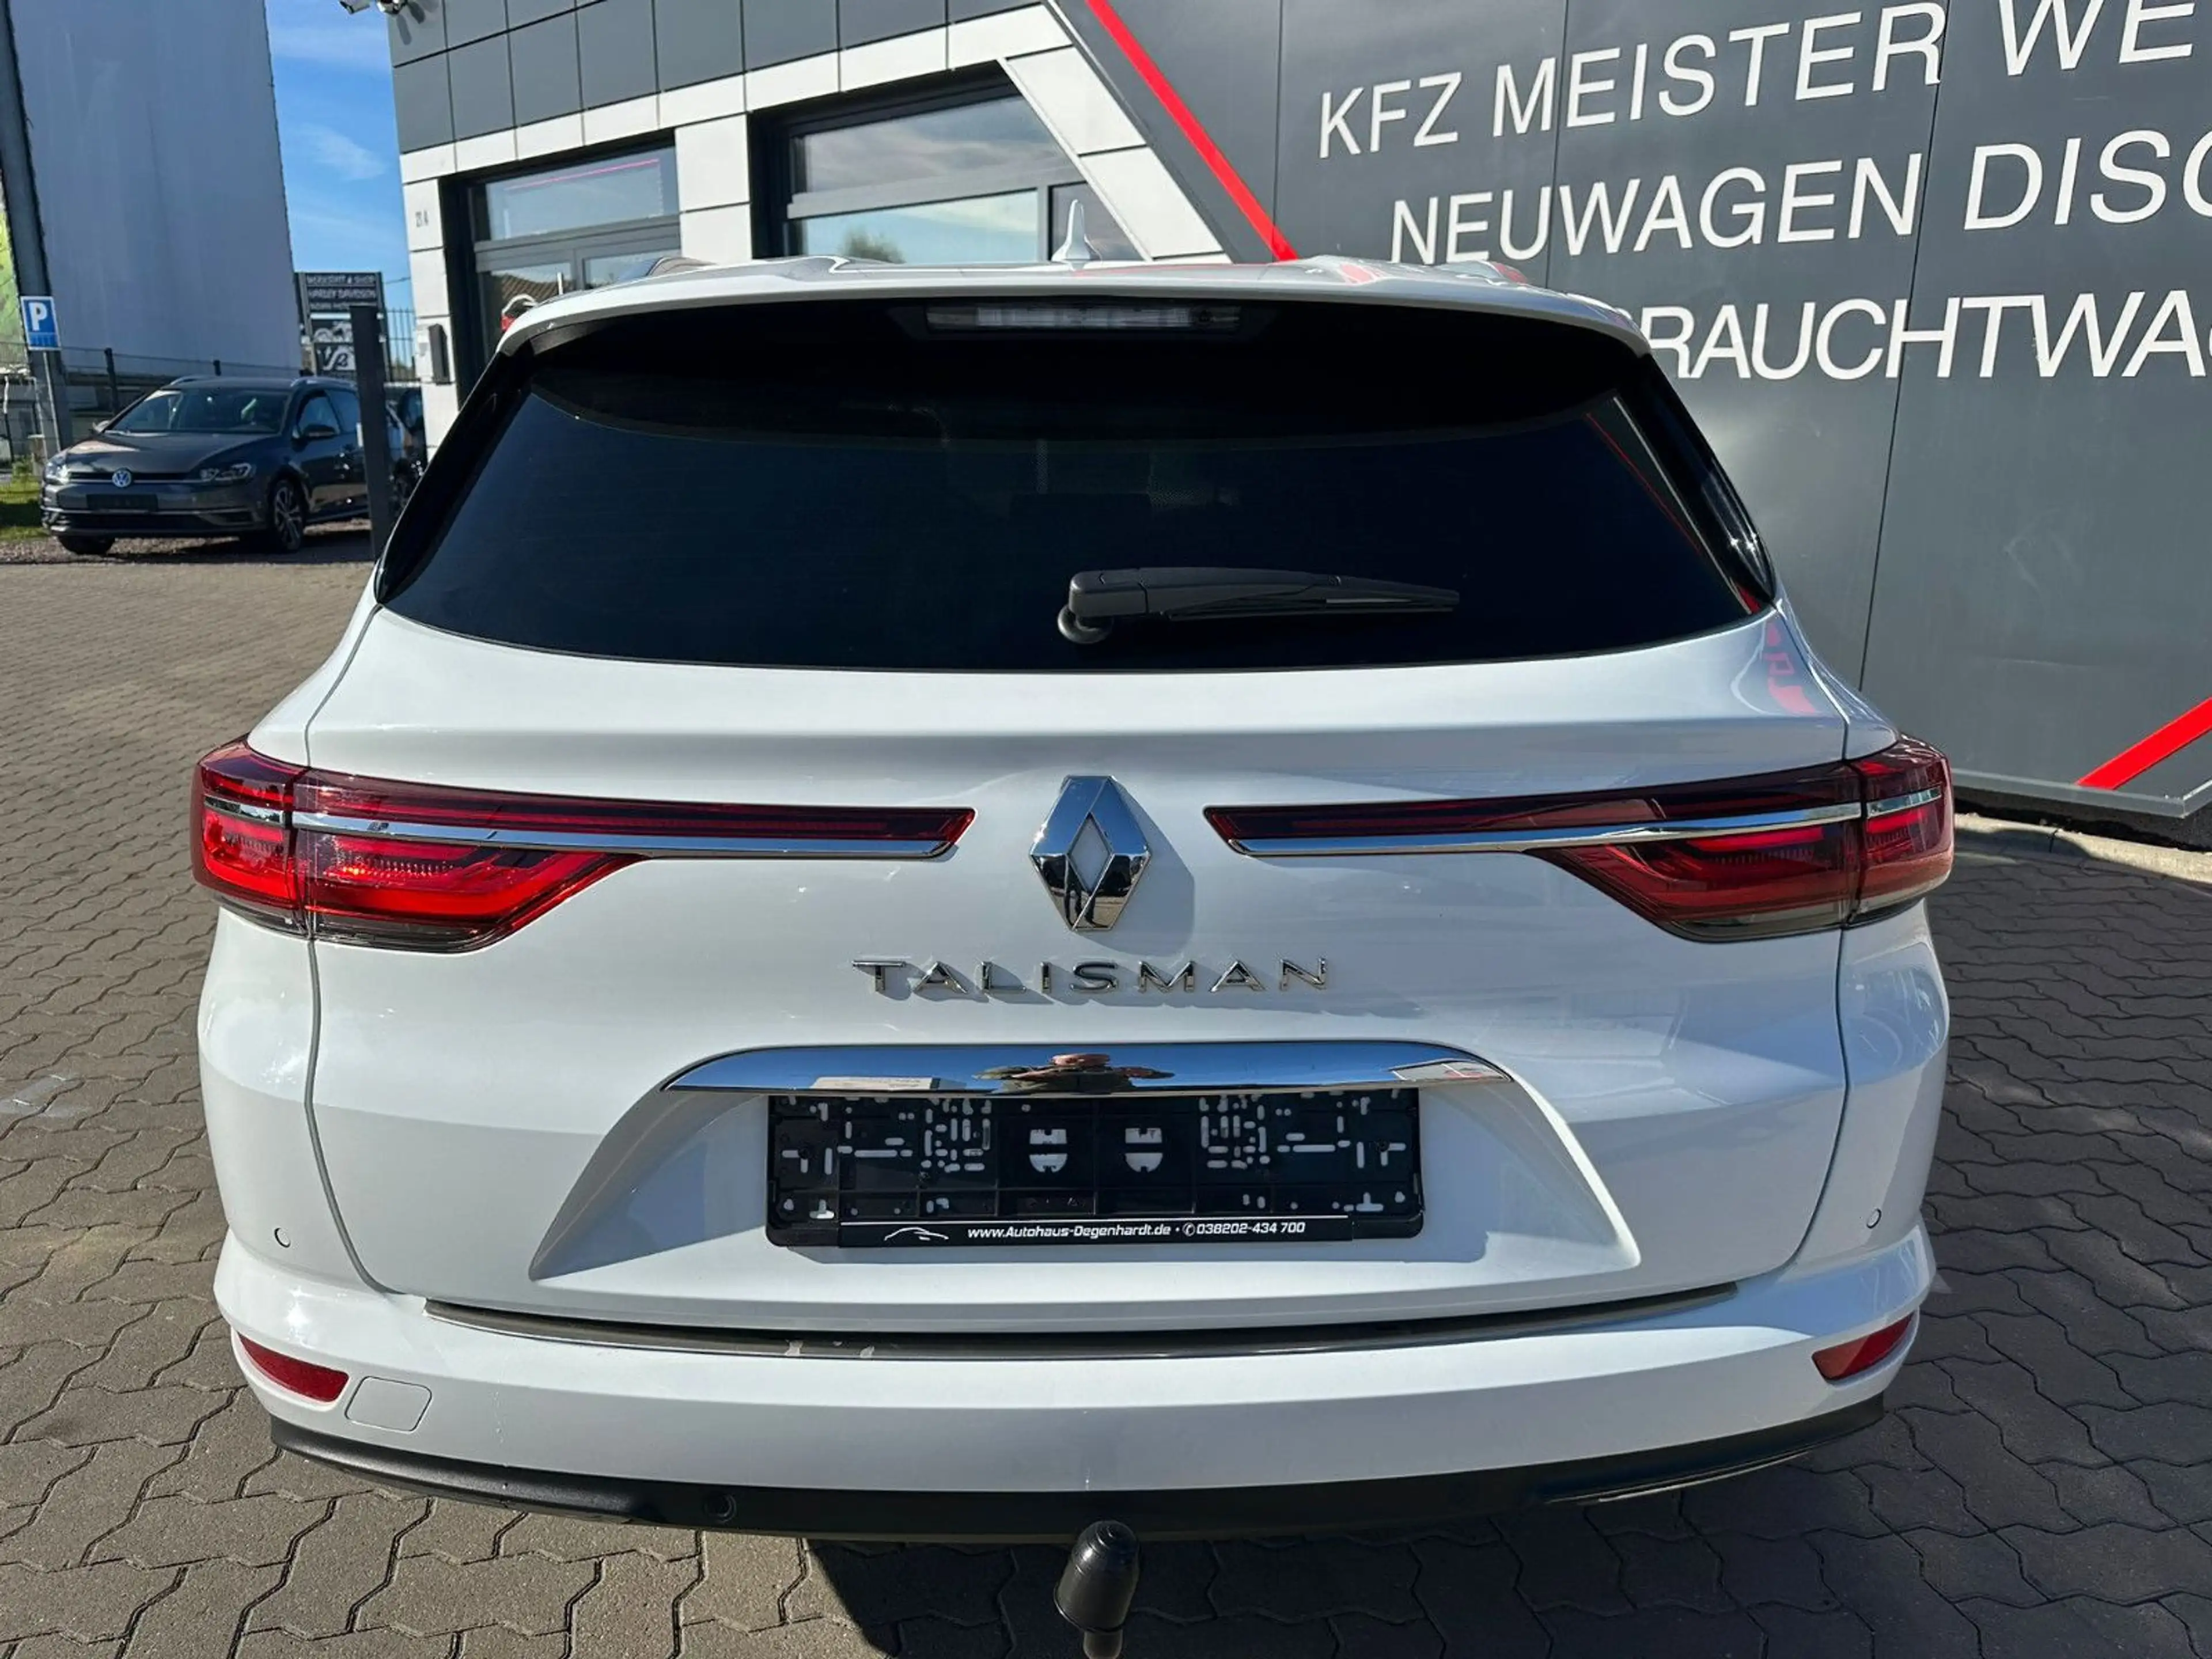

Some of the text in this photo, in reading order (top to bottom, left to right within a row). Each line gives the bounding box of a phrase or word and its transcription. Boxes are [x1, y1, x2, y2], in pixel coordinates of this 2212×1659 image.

[1319, 71, 1462, 158] KFZ
[1493, 2, 1947, 138] MEISTER
[1391, 153, 1922, 265] NEUWAGEN
[29, 302, 47, 331] P
[1641, 290, 2212, 381] RAUCHTWA
[852, 958, 1327, 993] TALISMAN
[968, 1222, 1306, 1239] www.Autohaus-Degenhardt.de 038202-434 700
